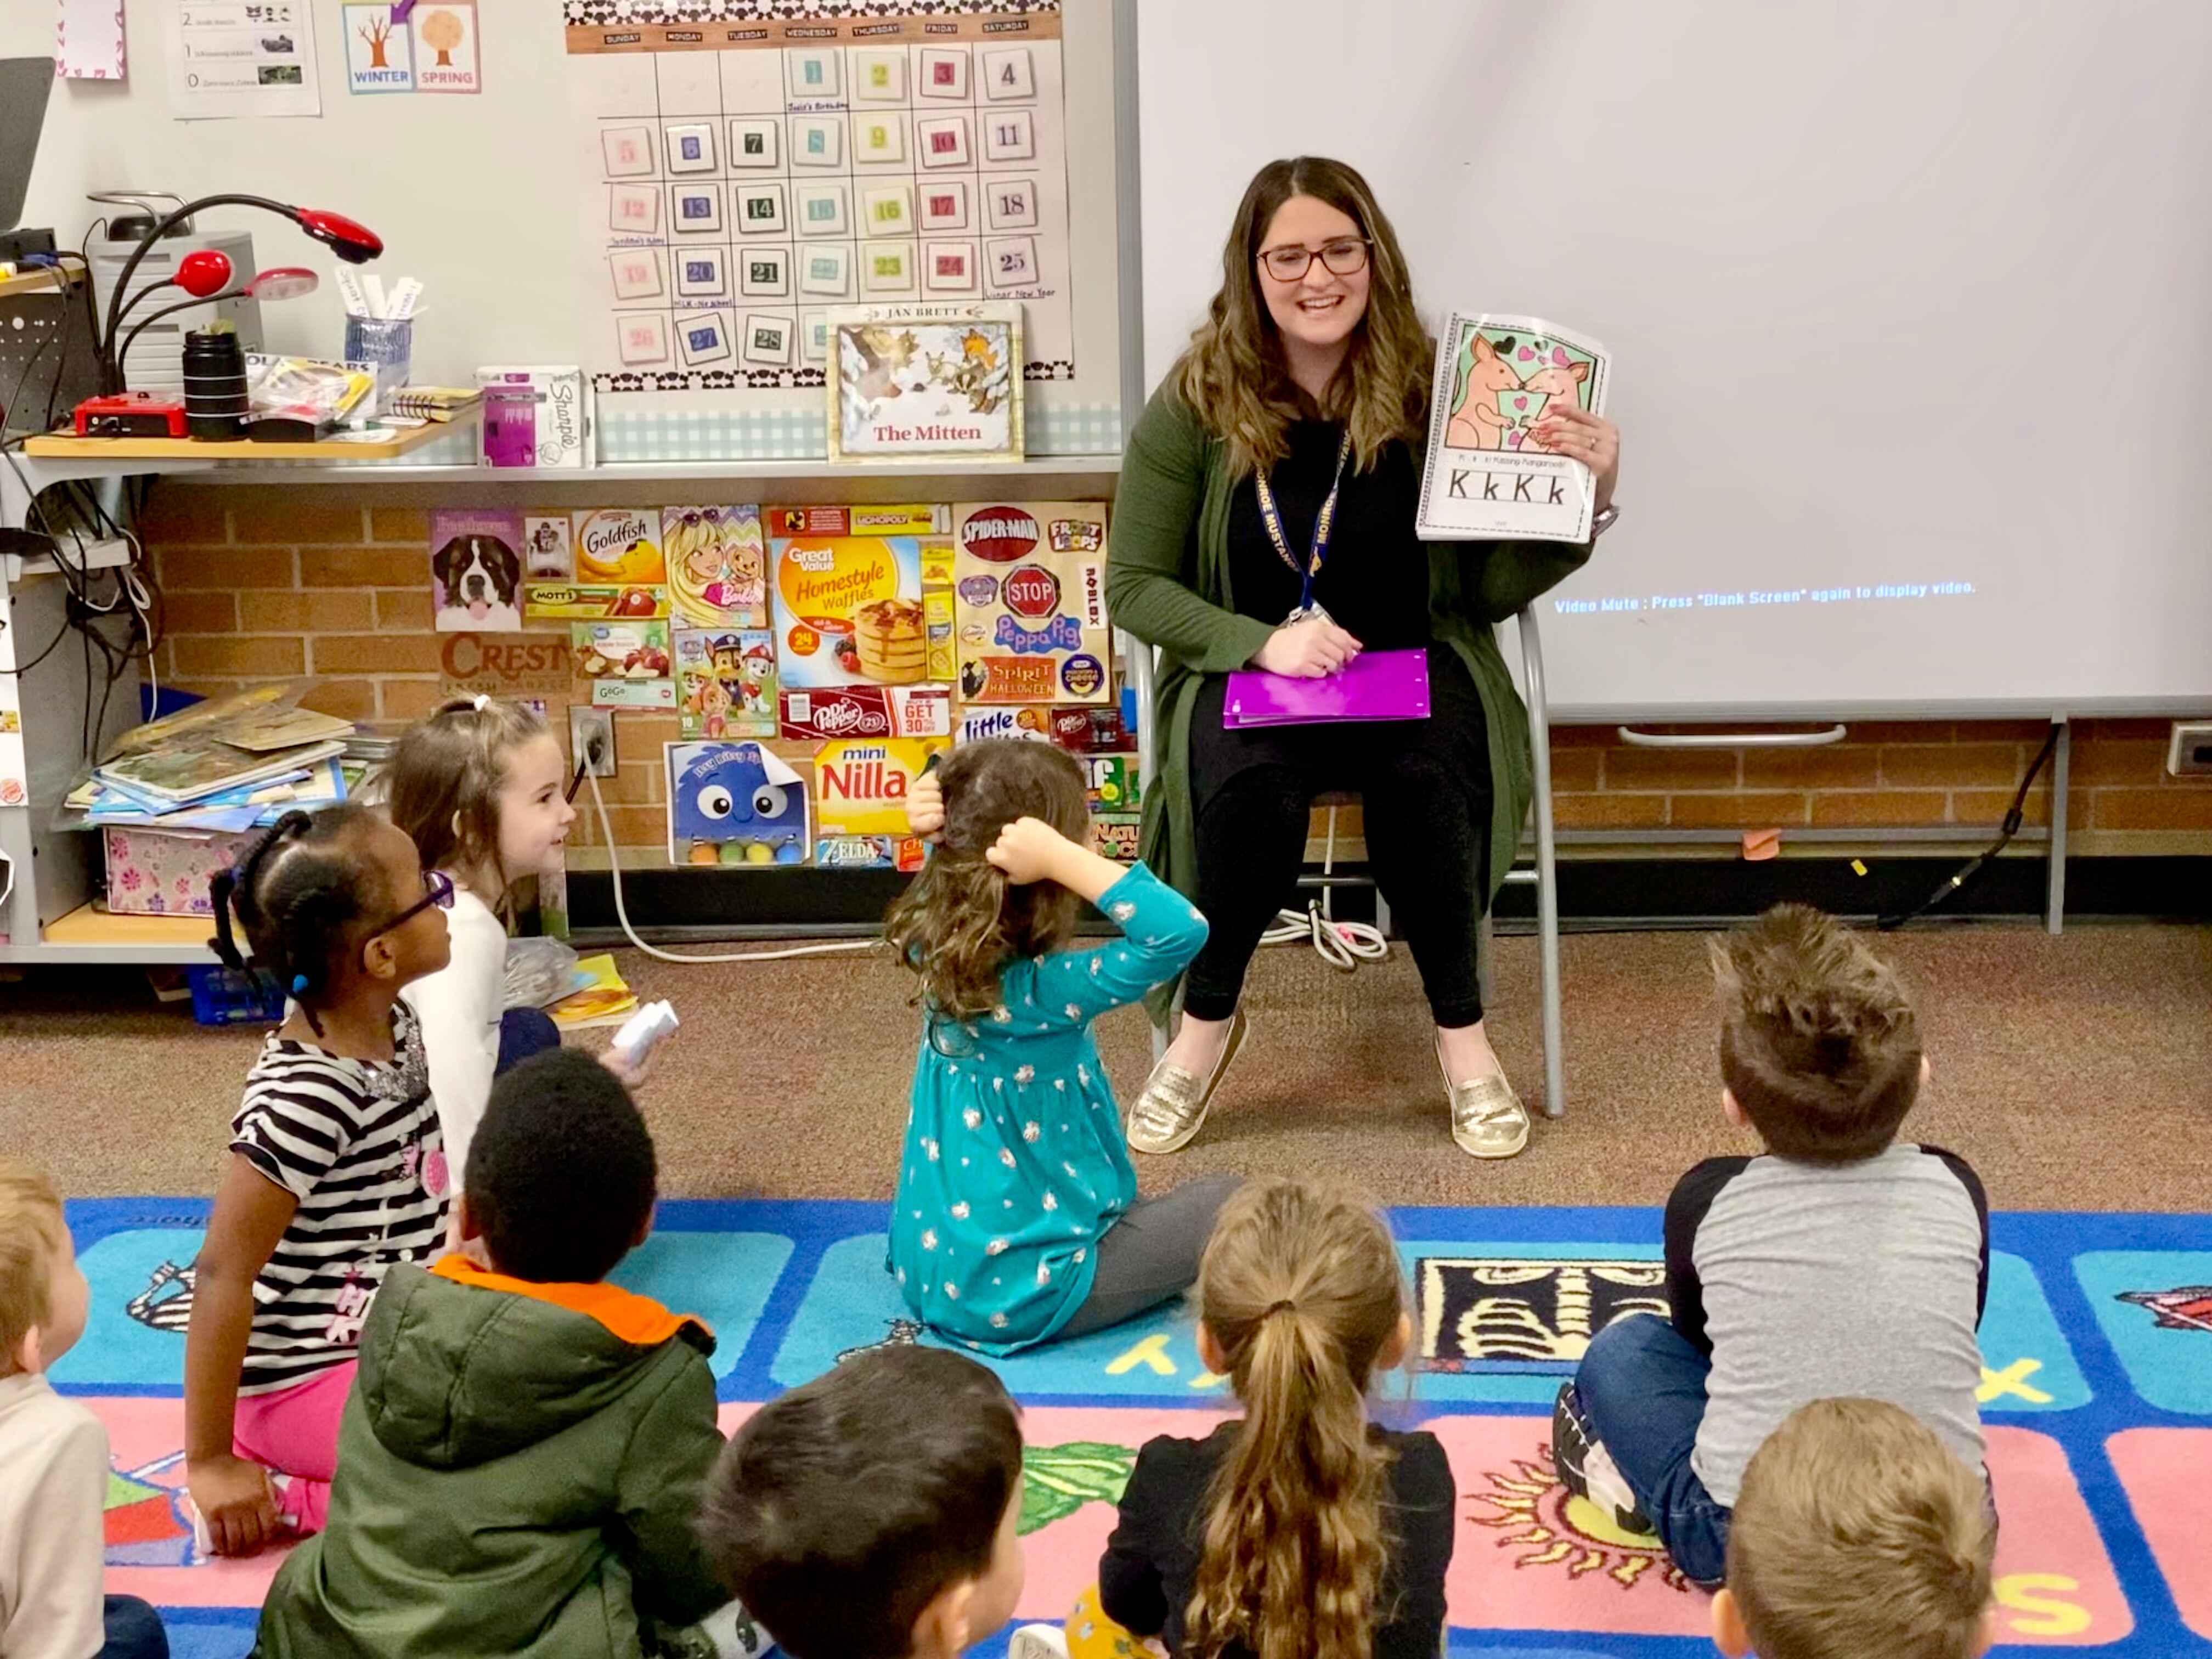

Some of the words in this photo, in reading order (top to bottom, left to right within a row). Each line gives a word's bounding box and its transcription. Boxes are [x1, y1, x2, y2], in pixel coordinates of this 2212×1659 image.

[183, 13, 191, 26] 2
[606, 34, 639, 43] SUNDAY
[667, 33, 702, 42] MONDAY
[729, 30, 766, 40] TUESDAY
[786, 29, 837, 37] WEDNESDAY
[854, 25, 899, 36] THURSDAY
[926, 25, 958, 33] FRIDAY
[984, 22, 1028, 32] SATURDAY
[354, 71, 408, 82] WINTER
[422, 72, 472, 83] SPRING
[872, 64, 888, 87] 2
[935, 63, 953, 84] 3
[1001, 63, 1015, 85] 4
[619, 140, 635, 162] 5
[683, 138, 699, 159] 6
[747, 134, 761, 153] 7
[809, 131, 824, 153] 8
[871, 126, 886, 148] 9
[932, 133, 956, 153] 10
[998, 125, 1020, 146] 11
[622, 200, 645, 218] 12
[685, 199, 709, 218] 13
[749, 199, 773, 218] 14
[877, 201, 900, 221] 16
[932, 196, 954, 216] 17
[1001, 195, 1025, 216] 18
[625, 265, 647, 284] 19
[687, 263, 714, 281] 20
[752, 263, 776, 281] 21
[874, 256, 901, 275] 23
[938, 256, 963, 275] 24
[1000, 253, 1025, 272] 25
[1015, 289, 1034, 298] New
[1037, 288, 1057, 297] Year
[886, 308, 911, 318] JAN
[916, 307, 960, 317] BRETT
[690, 329, 718, 351] 27
[755, 330, 781, 349] 28
[550, 383, 580, 450] Sharpie
[873, 426, 912, 442] The
[915, 424, 981, 441] Mitten
[1448, 469, 1470, 498] K
[1483, 472, 1499, 500] k
[1513, 473, 1534, 502] K
[1548, 476, 1564, 505] k
[857, 514, 908, 524] MONOPOLY
[1050, 521, 1100, 536] FROOT
[587, 519, 647, 554] Goldfish
[963, 518, 1039, 544] SPIDER-MAN
[1054, 534, 1098, 550] LOOPS
[789, 548, 833, 562] Great
[800, 560, 834, 572] Value
[796, 561, 884, 602] Homestyle
[823, 589, 874, 610] Waffles
[1011, 583, 1052, 602] STOP
[1086, 568, 1099, 625] ROBLOX
[1555, 599, 1596, 614] Video
[1601, 597, 1639, 611] Mute
[1651, 595, 1692, 610] Press
[1812, 588, 1851, 602] again
[1856, 586, 1870, 599] to
[1875, 583, 1927, 599] display
[1932, 581, 1976, 594] video.
[794, 633, 813, 646] 24
[997, 614, 1052, 651] Peppa
[1052, 616, 1081, 648] Pig
[442, 632, 569, 679] CREST
[993, 664, 1052, 681] SPIRIT
[990, 682, 1054, 695] HALLOWEEN
[834, 699, 849, 714] Dr
[905, 705, 934, 718] GET
[682, 716, 693, 728] 10
[815, 707, 859, 731] Pepper
[864, 716, 877, 727] 23
[905, 720, 923, 732] 30
[966, 712, 1013, 742] little
[843, 746, 886, 760] mini
[822, 762, 907, 800] Nilla
[820, 839, 876, 864] ZELDA
[1993, 1573, 2092, 1635] S
